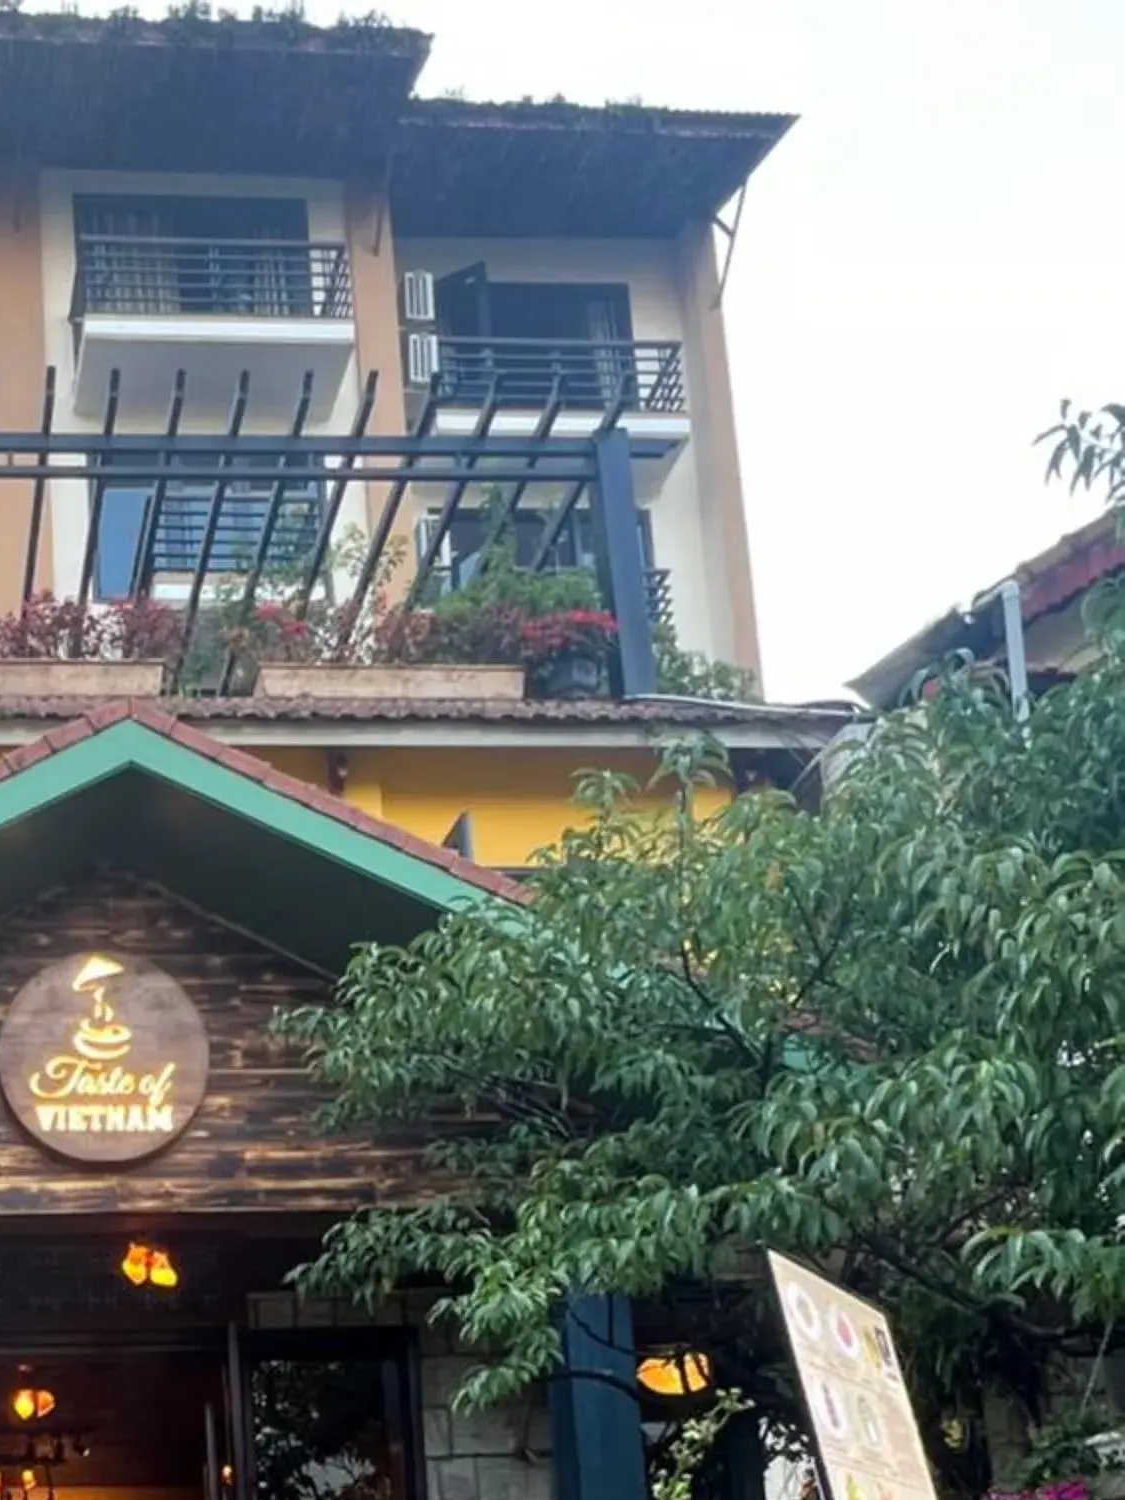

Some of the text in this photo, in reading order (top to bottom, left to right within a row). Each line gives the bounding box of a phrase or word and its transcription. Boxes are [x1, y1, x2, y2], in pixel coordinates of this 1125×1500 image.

[29, 1056, 176, 1106] Taste of
[35, 1104, 174, 1132] VIETNAM
